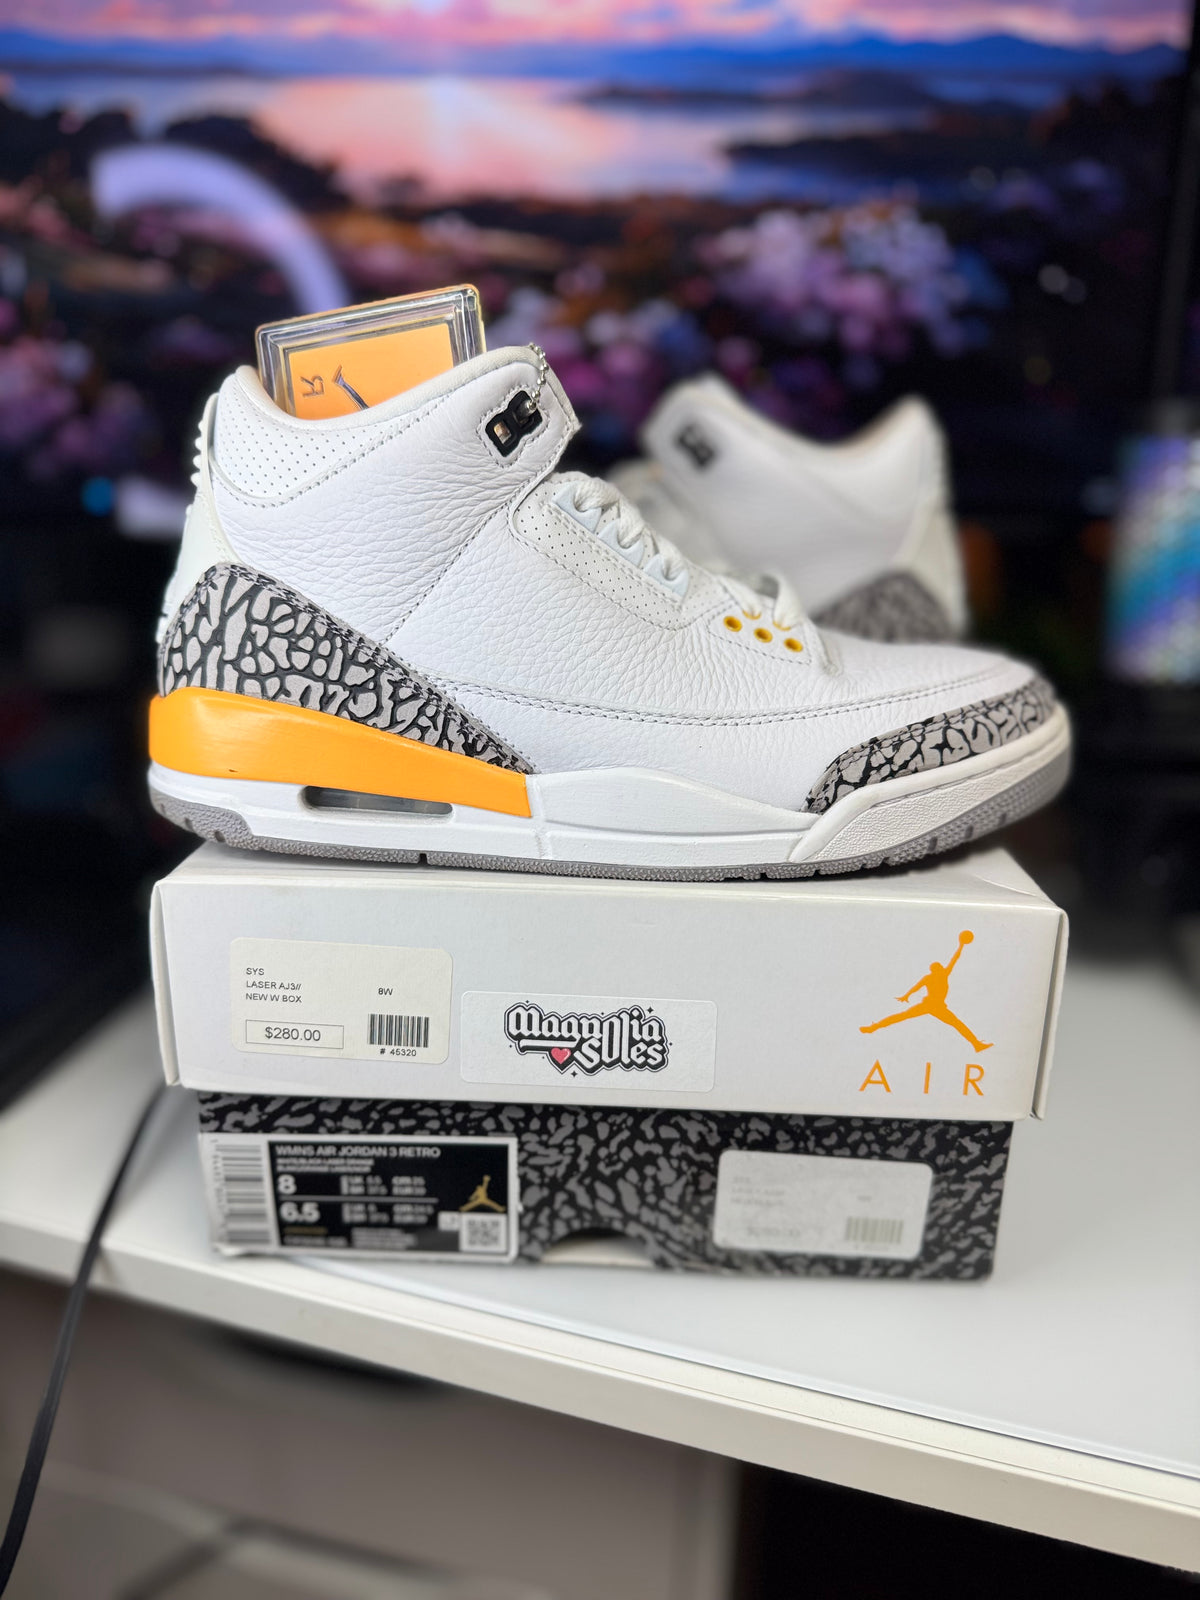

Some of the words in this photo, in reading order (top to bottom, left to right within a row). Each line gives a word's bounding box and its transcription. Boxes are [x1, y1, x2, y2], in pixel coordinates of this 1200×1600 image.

[245, 967, 265, 976] SYS
[246, 980, 277, 989] LASER
[378, 987, 393, 996] 8W
[245, 993, 269, 1002] NEW
[270, 994, 281, 1002] W
[282, 994, 302, 1004] BOX
[264, 1026, 321, 1042] $280.00
[389, 1048, 417, 1057] 45320
[858, 1059, 985, 1096] AIR
[275, 1145, 315, 1156] WMNS
[316, 1146, 336, 1157] AIR
[338, 1146, 388, 1158] JORDAN
[389, 1147, 399, 1158] 3
[399, 1146, 441, 1158] RETRO
[277, 1174, 297, 1195] 8
[279, 1201, 321, 1223] 6.5
